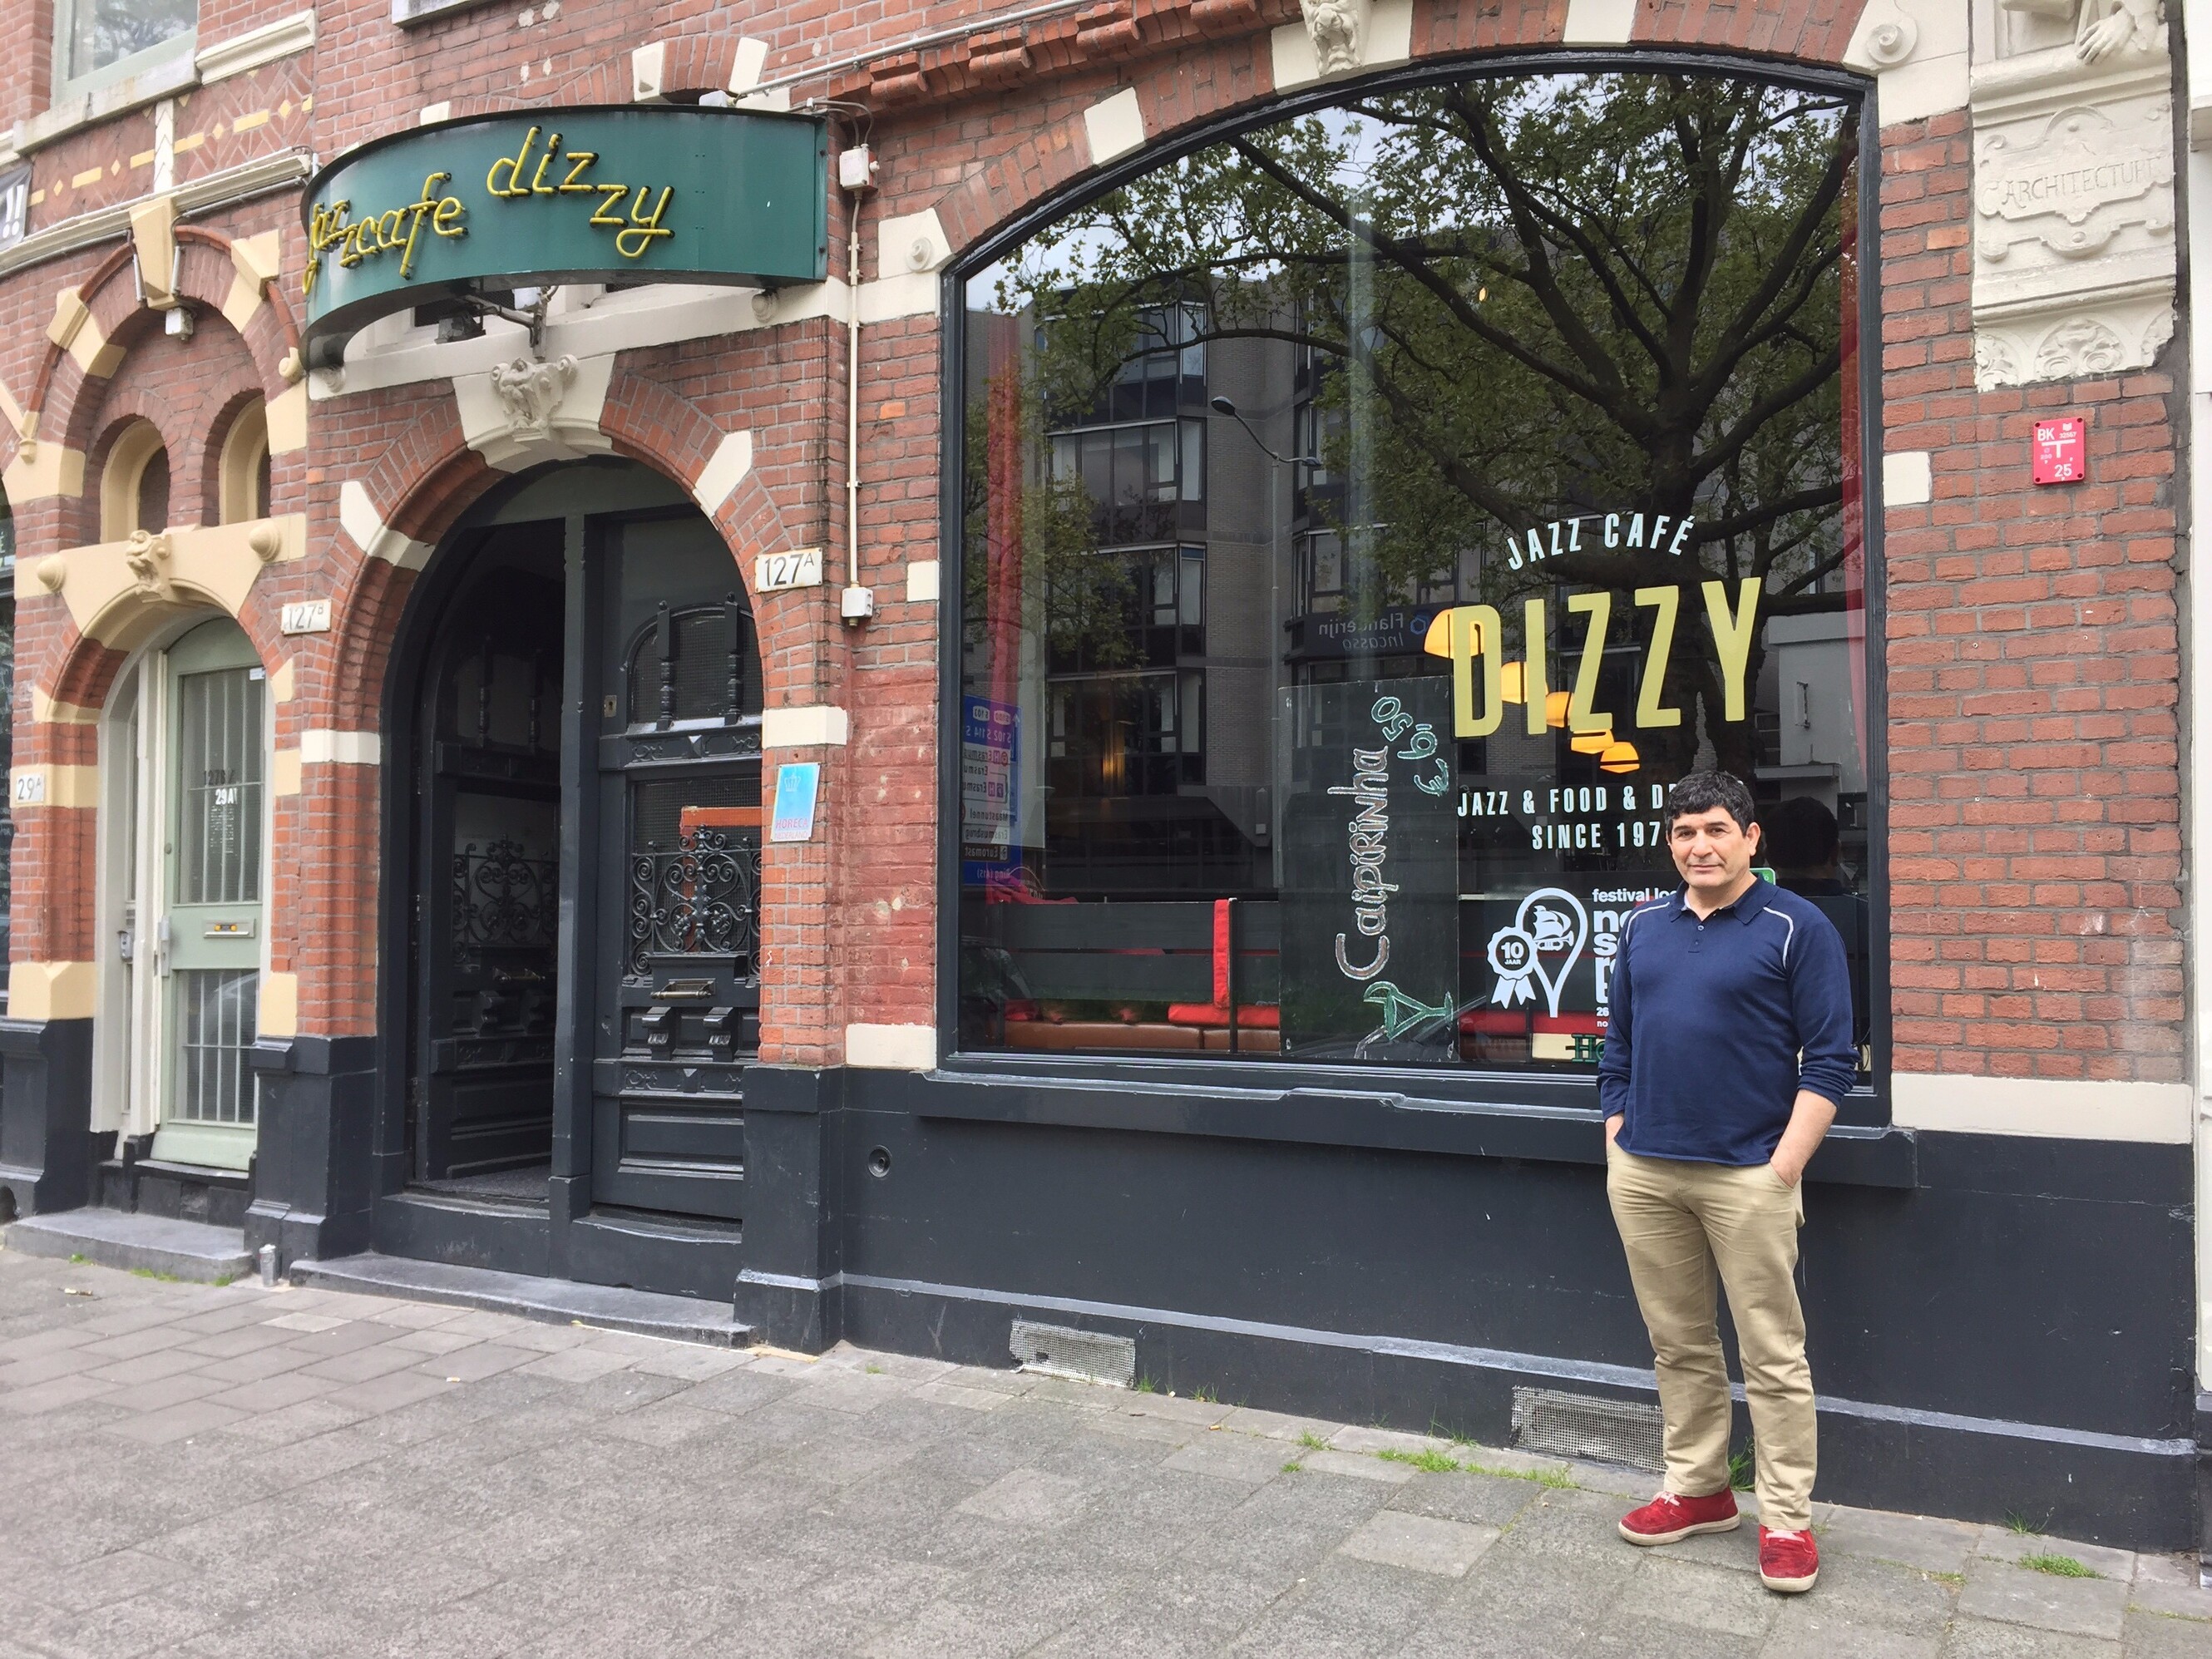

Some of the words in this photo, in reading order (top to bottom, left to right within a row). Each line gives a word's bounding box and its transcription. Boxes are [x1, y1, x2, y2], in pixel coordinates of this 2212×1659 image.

[486, 125, 675, 259] dizzy
[2037, 427, 2055, 442] BK
[2054, 463, 2072, 477] 25
[1506, 517, 1582, 571] JAZZ
[1604, 512, 1696, 556] CAFÉ
[764, 552, 815, 587] 127A
[288, 602, 324, 630] 127B
[1452, 576, 1762, 739] DIZZY
[18, 778, 42, 800] 29A
[1458, 790, 1508, 817] JAZZ
[1523, 789, 1536, 814] &
[1549, 787, 1607, 813] FOOD
[1622, 785, 1636, 811] &
[775, 817, 809, 829] HORECA
[1532, 823, 1602, 850] SINCE
[1617, 821, 1661, 847] 197
[1592, 887, 1650, 903] festival
[1500, 941, 1524, 960] 10
